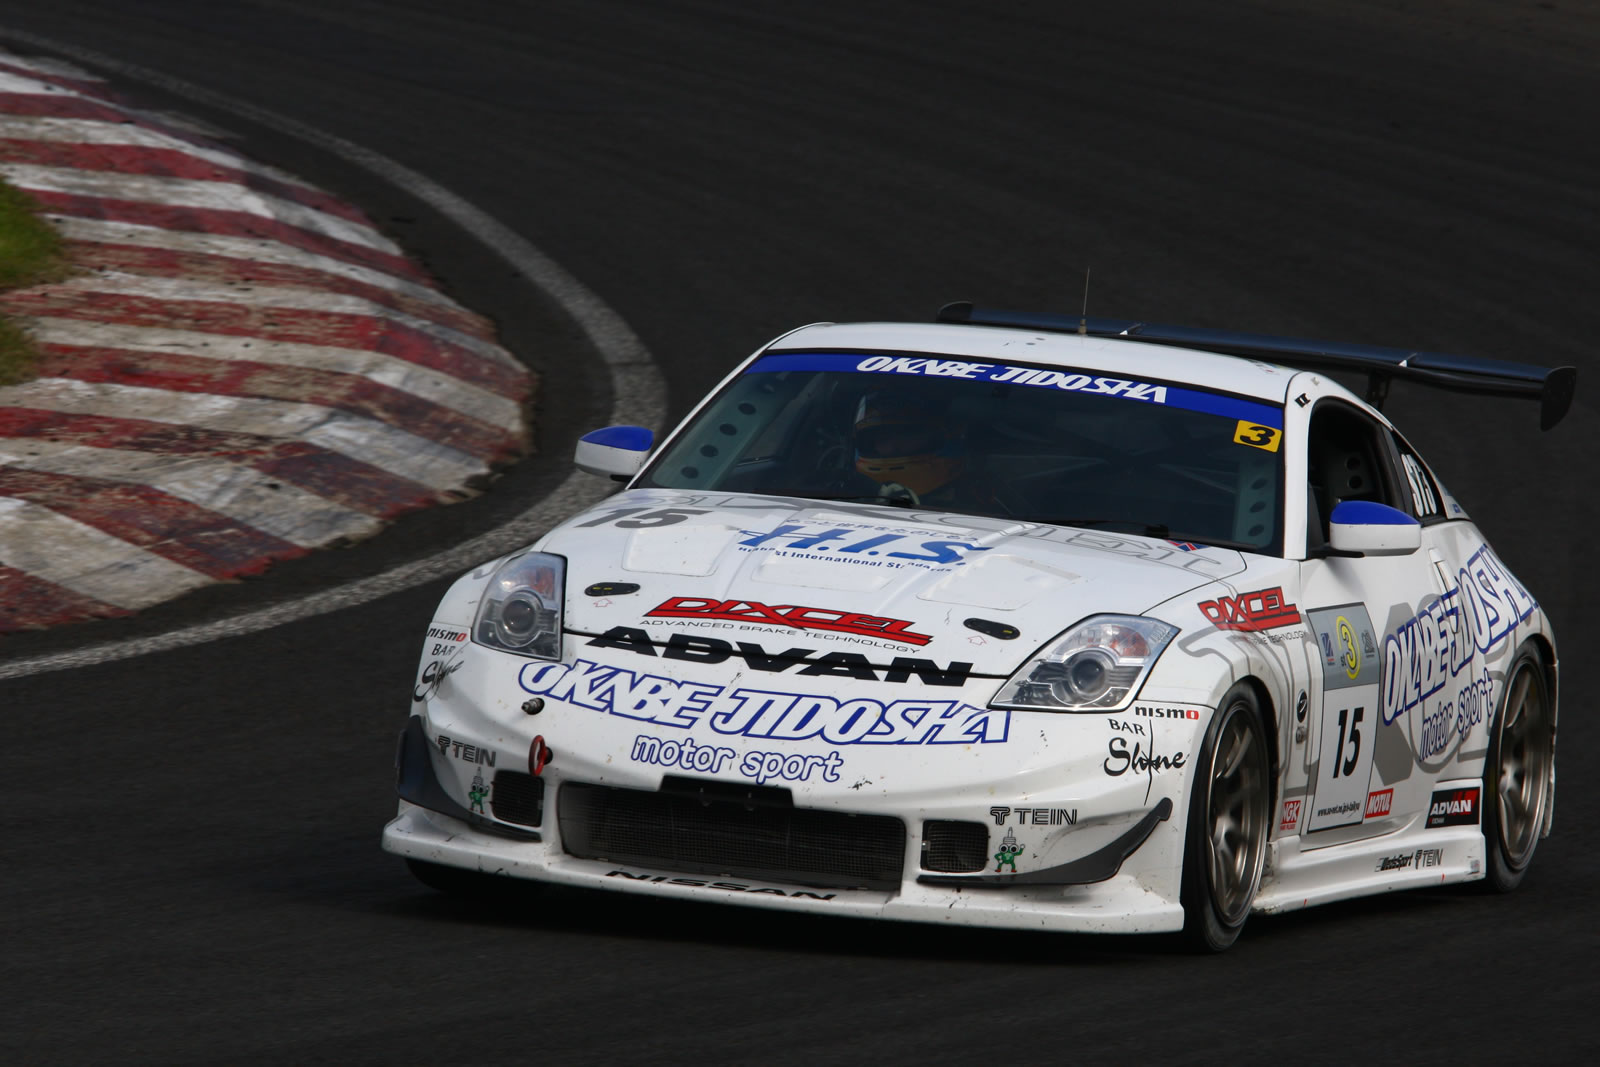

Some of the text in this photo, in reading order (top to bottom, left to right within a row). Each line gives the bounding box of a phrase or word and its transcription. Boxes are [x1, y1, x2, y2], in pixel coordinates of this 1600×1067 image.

[856, 355, 1167, 404] OKABE JIDOSHA
[1239, 425, 1275, 448] 3
[576, 508, 711, 529] 15
[737, 524, 995, 566] H.I.S.
[791, 552, 882, 567] International
[642, 596, 934, 647] DIXCEL
[1197, 586, 1302, 634] DIXCEL
[427, 628, 467, 642] nismo
[640, 619, 921, 654] ADVANCED BRAKE TECHNOLOGY
[586, 626, 973, 687] ADVAN
[1382, 600, 1453, 726] OKABE
[518, 659, 1011, 745] OKABE JIDOSHA
[1135, 706, 1199, 720] nismo
[1419, 667, 1494, 763] motor sport
[1108, 718, 1146, 737] BAR
[1333, 706, 1364, 779] 15
[452, 740, 496, 767] TEIN
[631, 734, 844, 785] motor sport
[1014, 808, 1078, 826] TEIN
[1367, 793, 1392, 815] MOTUL
[1430, 799, 1472, 816] ADVAN
[1423, 848, 1446, 868] TEIN
[605, 870, 838, 902] NISSAN
